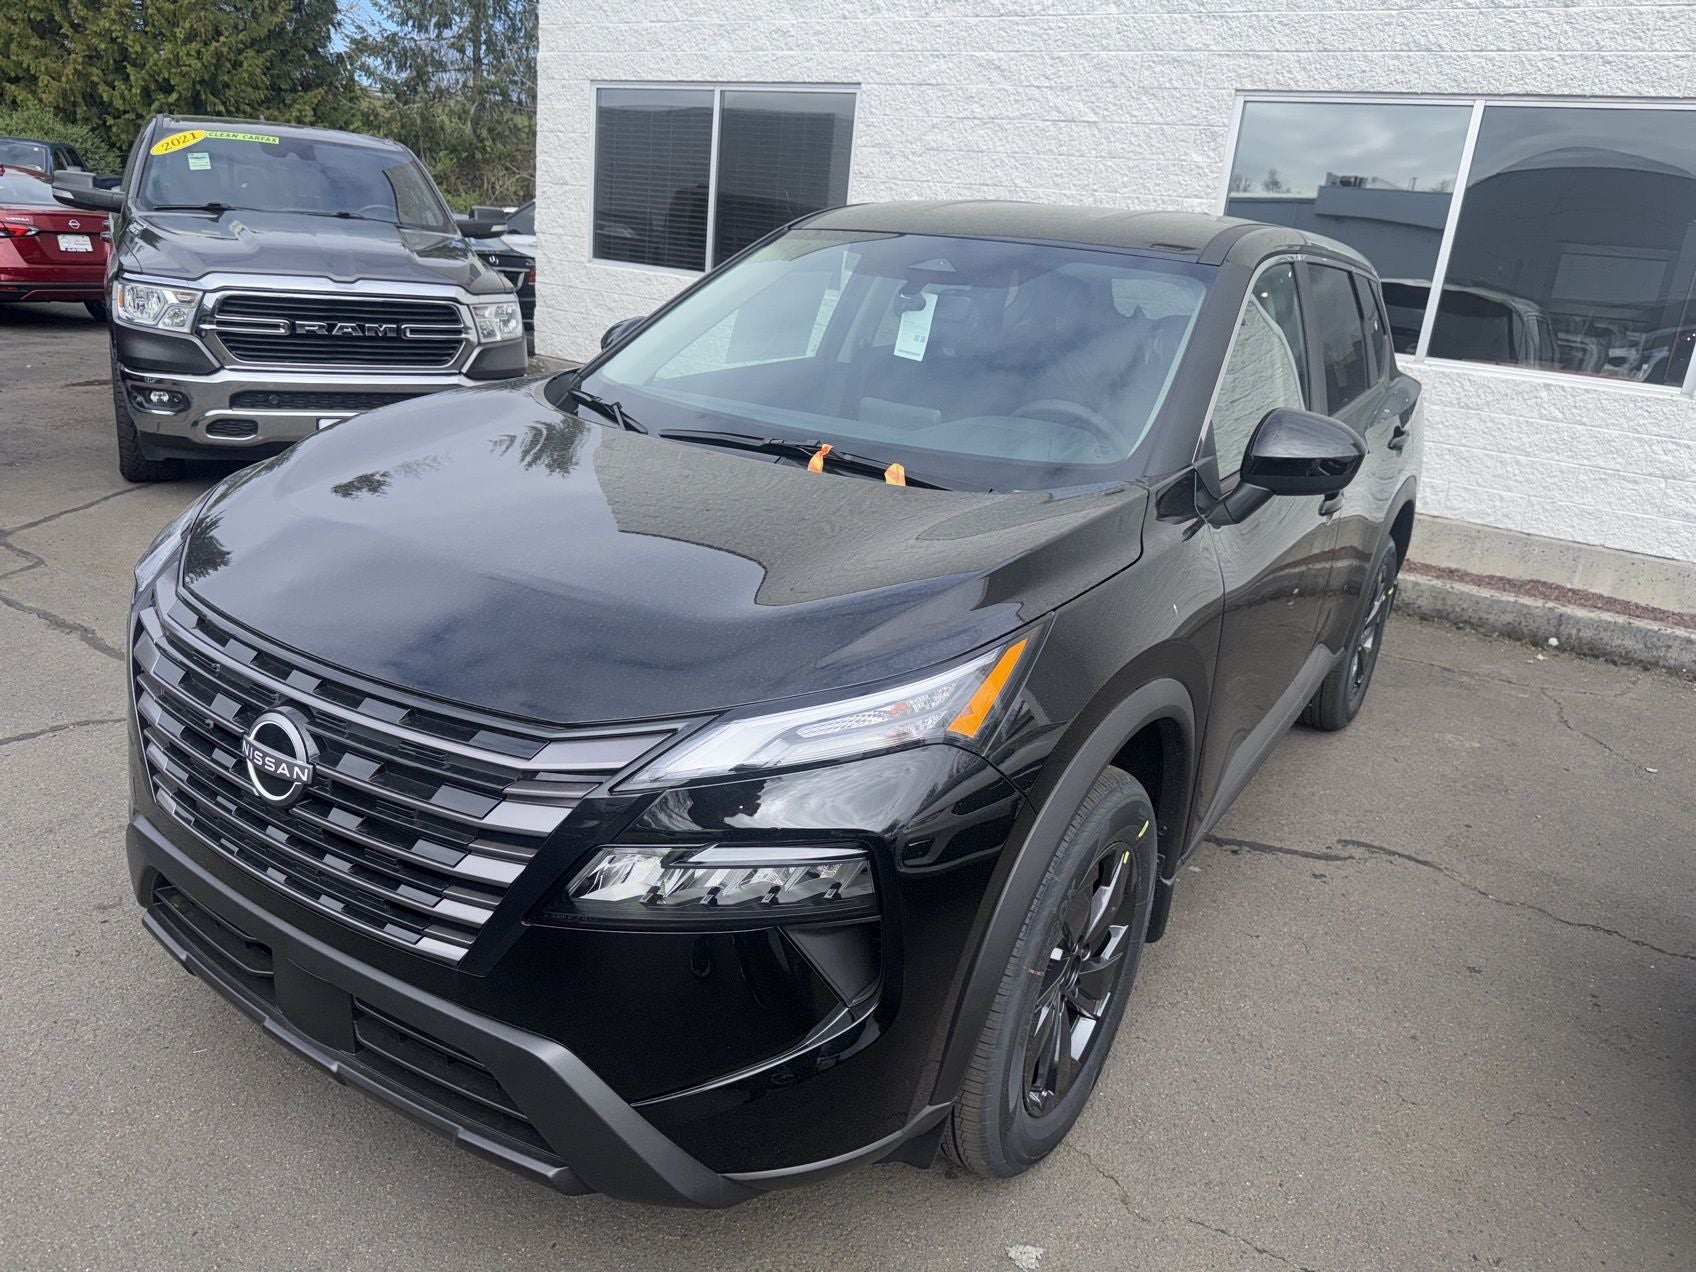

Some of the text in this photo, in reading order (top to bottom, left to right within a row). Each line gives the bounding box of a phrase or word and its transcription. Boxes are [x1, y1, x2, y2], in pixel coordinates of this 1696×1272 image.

[161, 132, 198, 151] 2021
[242, 134, 278, 143] CARFAX
[295, 320, 398, 337] RAM
[242, 740, 309, 782] NISSAN
